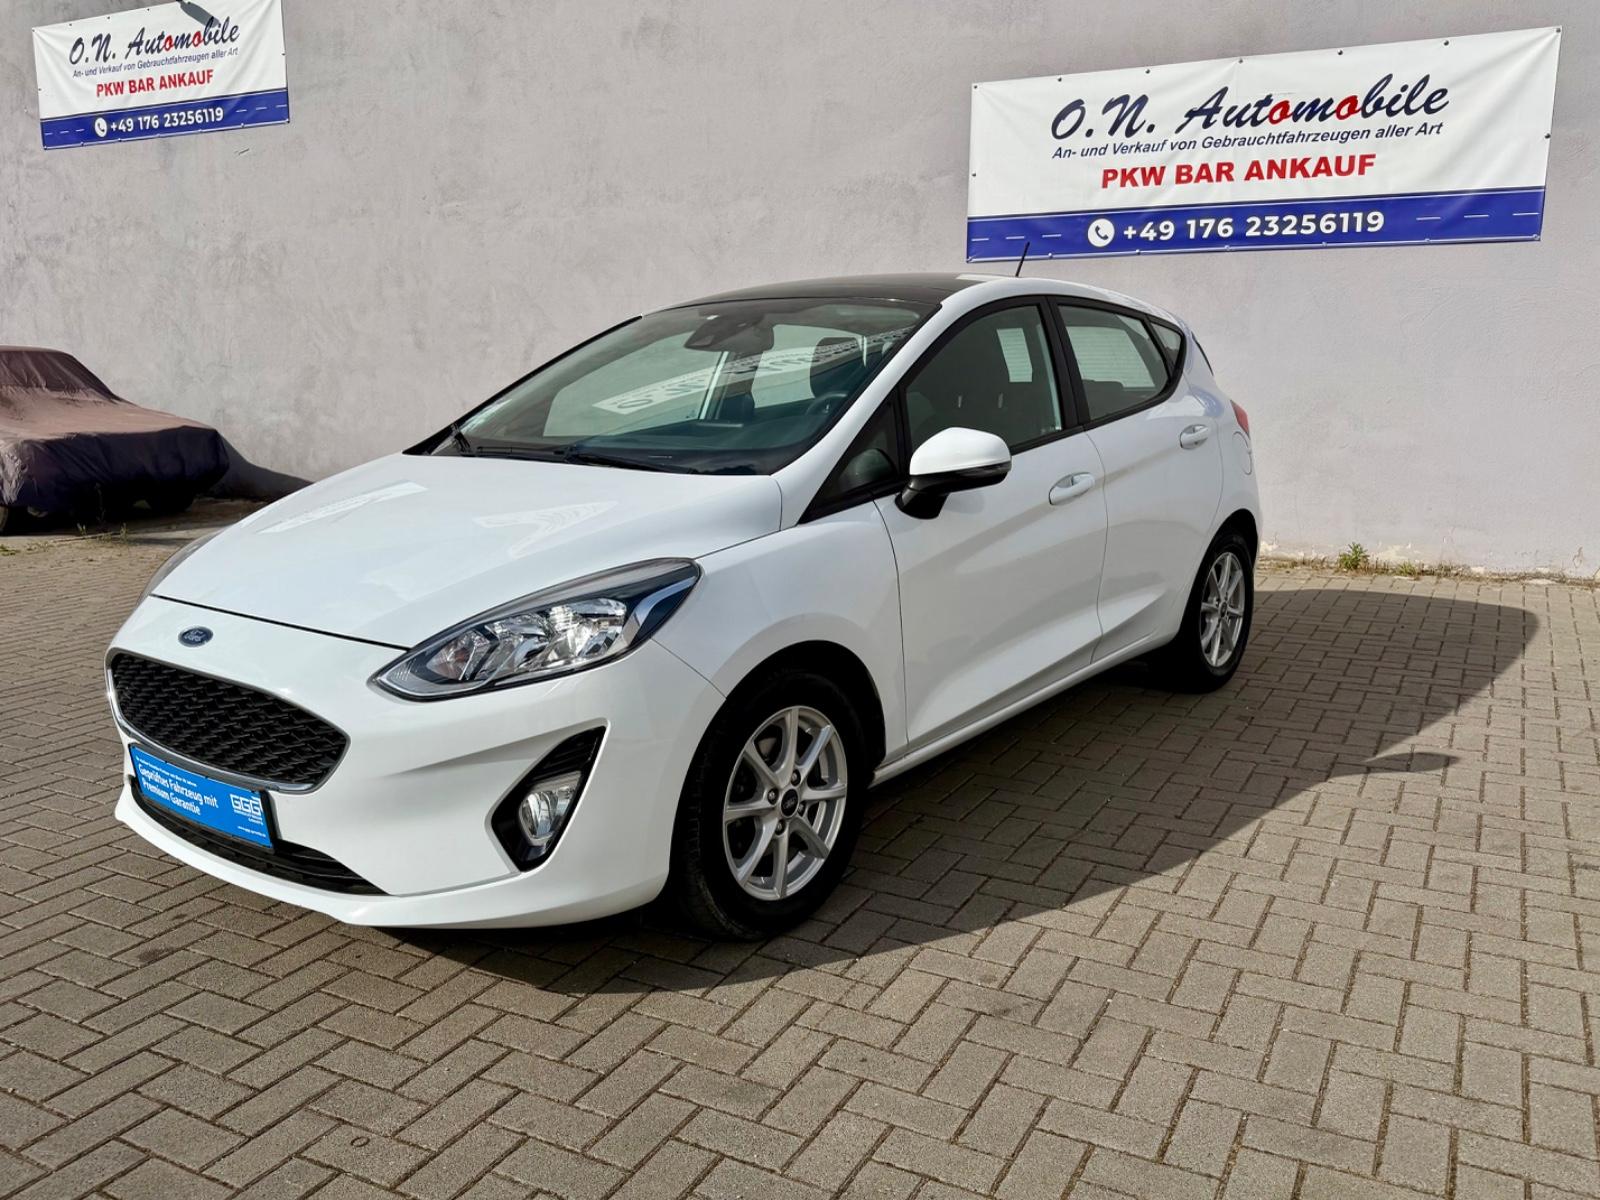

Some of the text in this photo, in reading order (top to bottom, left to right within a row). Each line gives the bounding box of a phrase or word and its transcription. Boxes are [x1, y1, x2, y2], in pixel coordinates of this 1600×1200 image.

[69, 15, 240, 65] O.N. Automobile
[72, 47, 239, 79] An- und Verkauf von Gebrauchtfahrzeugen aller Art
[96, 69, 214, 98] PKW BAR ANKAUF
[110, 106, 224, 133] +49 176 23256119
[1051, 73, 1449, 140] O.N. Automobile
[1052, 121, 1444, 159] An- und Verkauf von Gebrauchtfahrzeugen aller Art
[1101, 153, 1376, 189] PKW BAR ANKAUF
[1123, 210, 1385, 241] +49 176 23256119
[141, 777, 201, 816] Premium Garantie
[168, 778, 203, 806] Fahrzeug
[203, 795, 219, 809] mit
